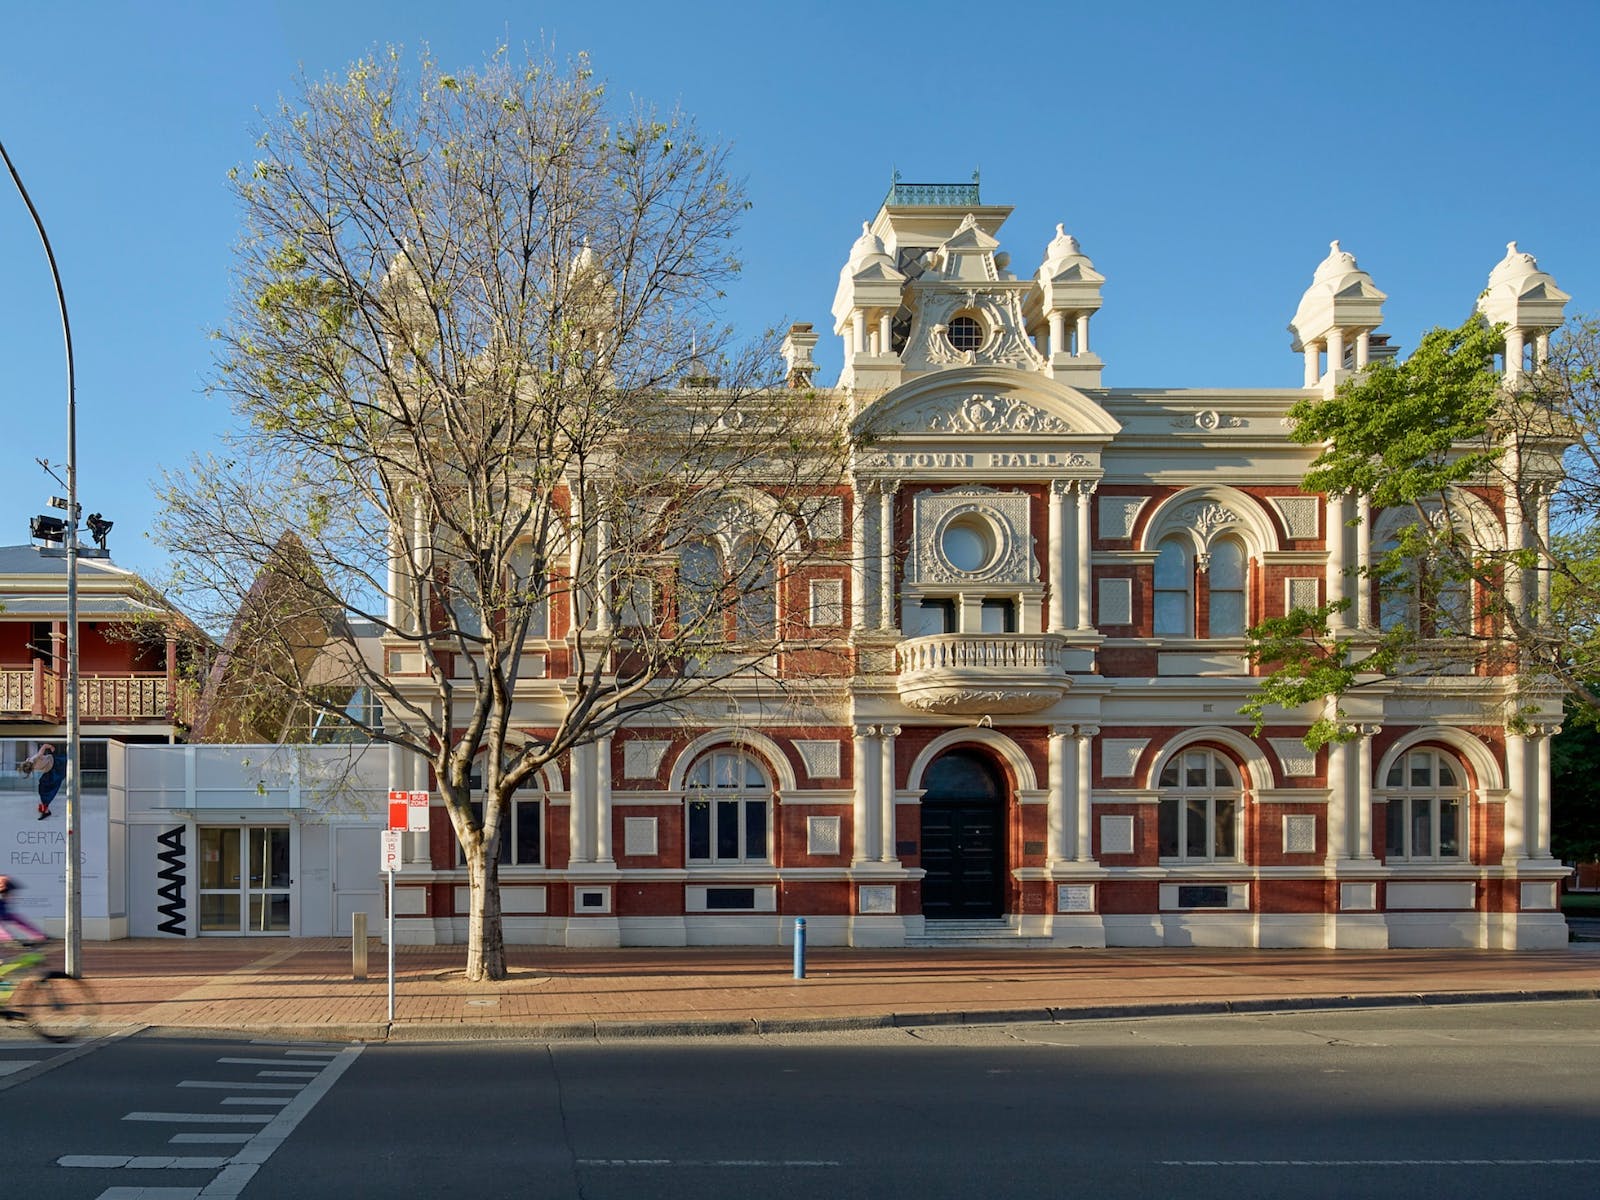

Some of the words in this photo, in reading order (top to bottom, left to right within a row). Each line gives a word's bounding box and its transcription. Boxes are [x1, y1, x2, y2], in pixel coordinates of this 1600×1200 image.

[896, 453, 969, 467] TOWN
[989, 453, 1060, 467] HALL
[16, 831, 66, 845] CERTA
[387, 853, 396, 863] P
[157, 824, 186, 936] MAMA
